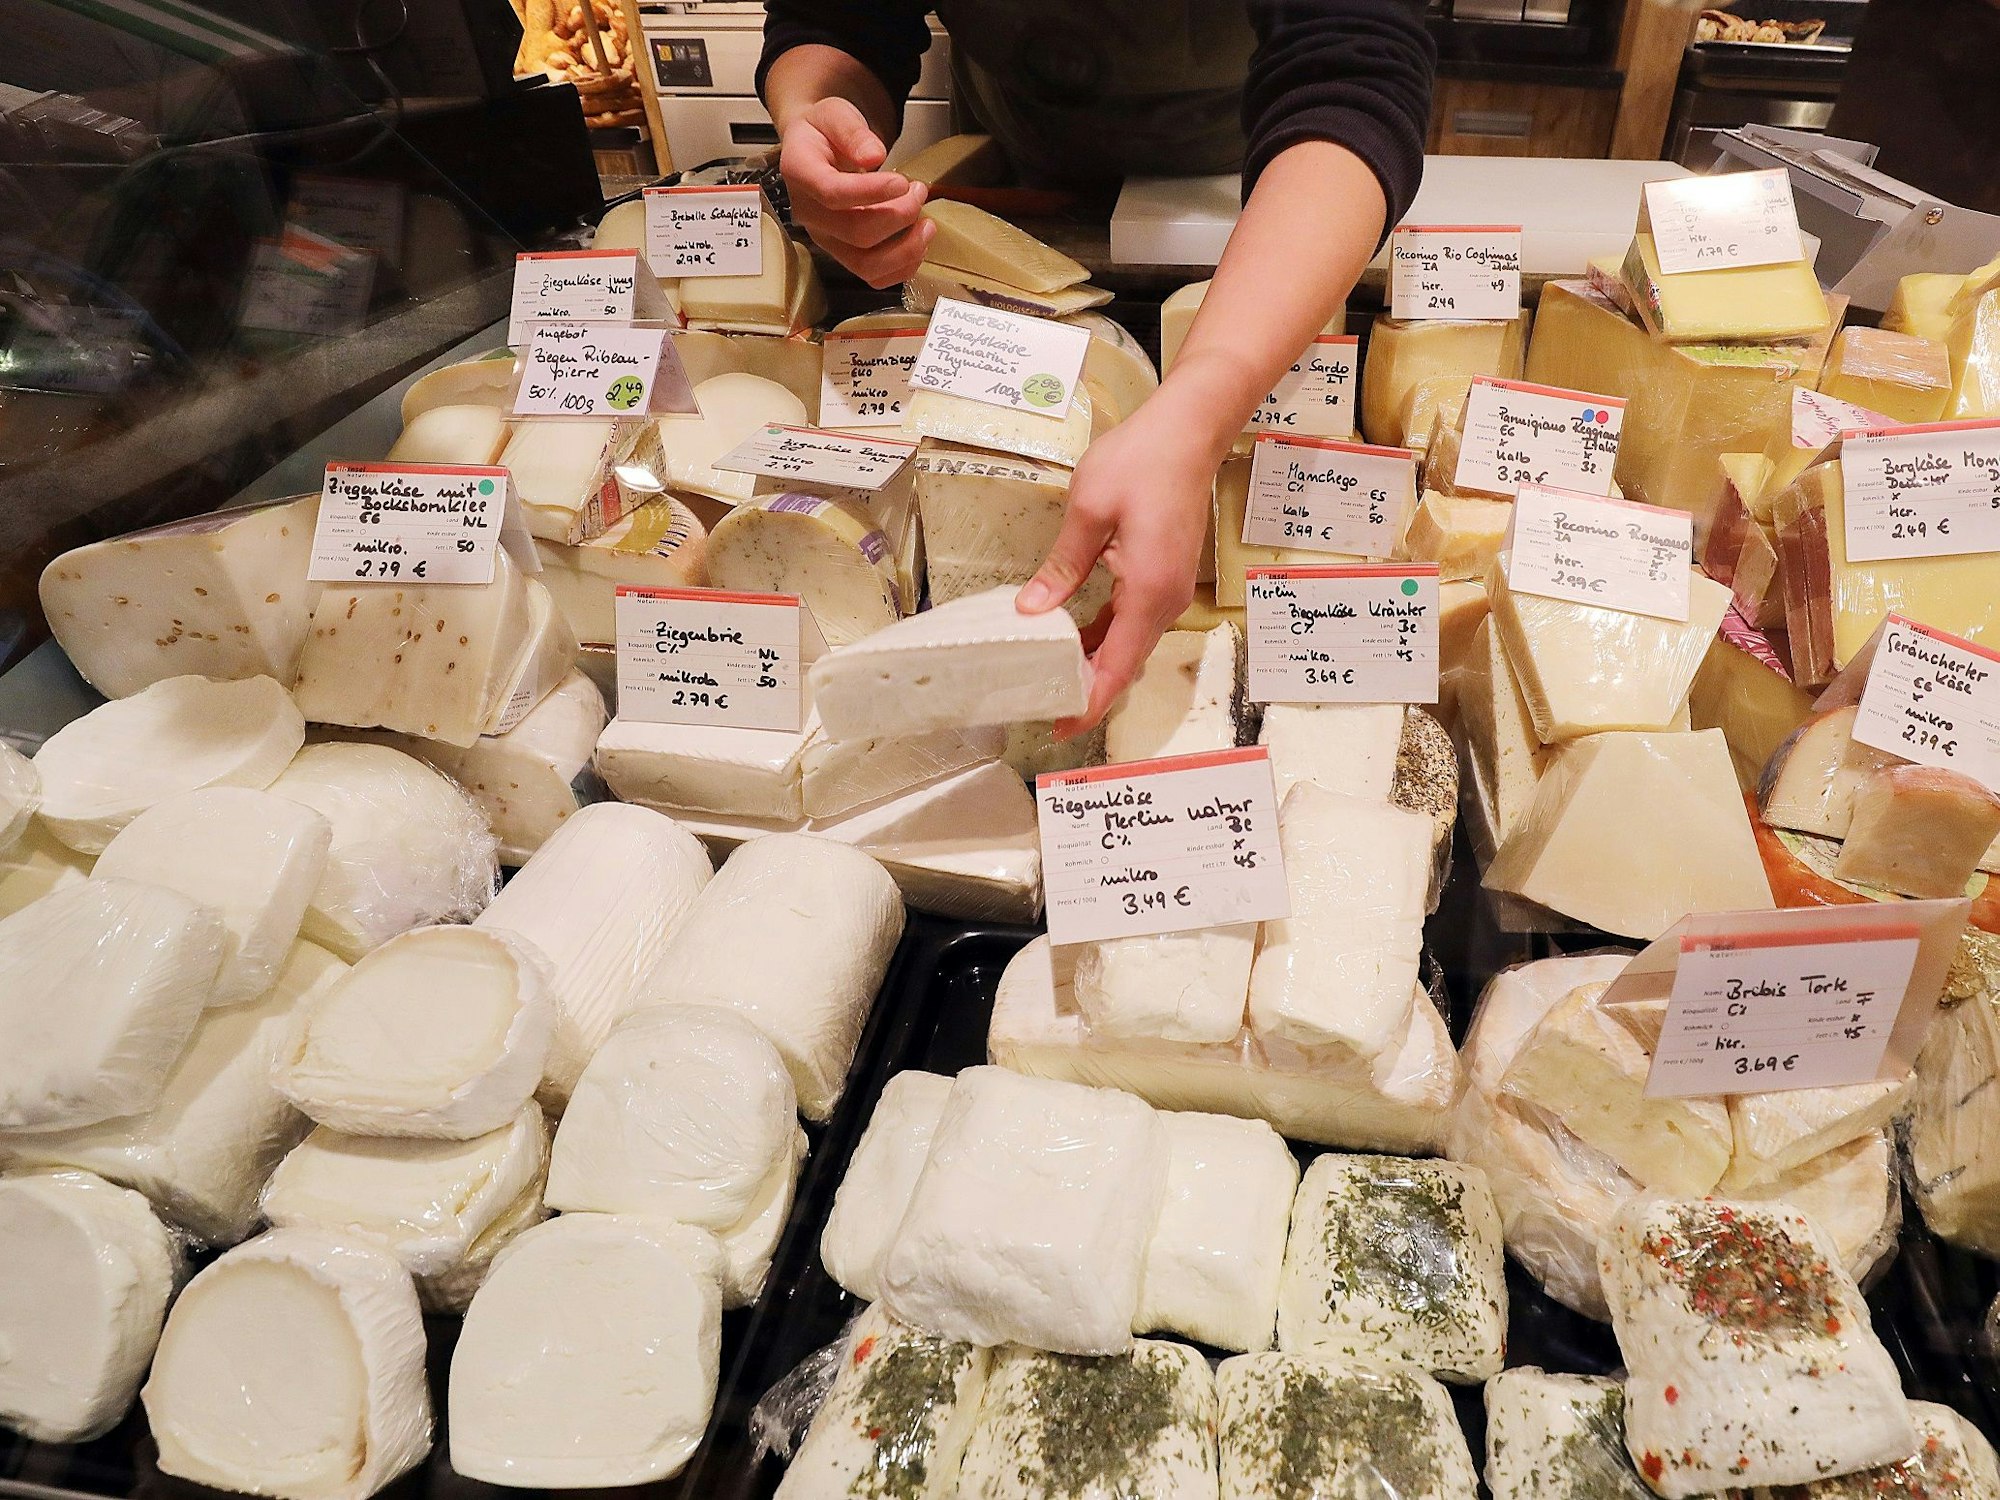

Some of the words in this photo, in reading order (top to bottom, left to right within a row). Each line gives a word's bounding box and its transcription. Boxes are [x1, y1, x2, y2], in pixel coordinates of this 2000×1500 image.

[670, 210, 706, 222] Brebelle
[710, 208, 758, 220] Schafskäse
[1765, 226, 1778, 234] 50
[735, 239, 748, 247] 53
[1395, 247, 1438, 261] Pecorino
[1443, 247, 1461, 260] Rio
[1698, 247, 1723, 258] 1.79
[1728, 244, 1738, 256] €
[676, 254, 701, 265] 2.99
[706, 253, 715, 264] €
[1422, 262, 1438, 271] IA
[543, 274, 601, 291] Ziegenkäse
[606, 275, 633, 289] jung
[1491, 279, 1504, 291] 49
[1428, 297, 1454, 308] 2.49
[604, 306, 616, 315] 50
[536, 328, 588, 339] Angebot
[935, 325, 1031, 357] Schafskäse
[535, 348, 577, 366] Ziegen
[1309, 358, 1349, 373] Sardo
[550, 368, 598, 380] pierre
[985, 382, 1022, 405] 100g
[1045, 391, 1062, 404] €
[560, 392, 594, 414] 100g
[627, 396, 640, 408] €
[858, 403, 885, 415] 2.79
[891, 401, 900, 412] €
[1251, 410, 1280, 424] 2.79
[1283, 413, 1297, 425] €
[1499, 407, 1566, 437] Parmigiano
[765, 462, 801, 472] 2.49
[1581, 461, 1596, 474] 32
[1882, 454, 1952, 477] Bergkäse
[1288, 462, 1358, 491] Manchego
[329, 477, 424, 500] Ziegenkäse
[437, 483, 476, 498] mit
[1370, 490, 1387, 502] ES
[362, 497, 488, 513] Bockshornklee
[1283, 505, 1309, 518] Kalb
[462, 516, 488, 528] NL
[1369, 513, 1383, 524] 50
[1284, 522, 1313, 538] 3.99
[1321, 527, 1334, 539] €
[1554, 512, 1619, 539] Pecorino
[1626, 524, 1690, 551] Romano
[1892, 523, 1927, 538] 2.49
[1937, 518, 1950, 534] €
[353, 540, 407, 555] mikro.
[456, 540, 475, 552] 50
[356, 560, 401, 577] 2.79
[413, 560, 427, 578] €
[1551, 570, 1587, 590] 2.99
[1589, 579, 1607, 593] €
[1251, 585, 1296, 598] Merlin
[1289, 603, 1357, 623] Ziegenkäse
[1369, 599, 1426, 617] Kräuter
[656, 622, 743, 648] Ziegenbrie
[758, 648, 780, 660] NL
[1396, 650, 1413, 661] 45
[756, 676, 777, 688] 50
[1305, 668, 1337, 684] 3.69
[1343, 669, 1354, 684] €
[1936, 671, 1972, 695] Käse
[672, 691, 709, 706] 2.79
[715, 694, 729, 709] €
[1905, 707, 1954, 731] mikro
[1902, 724, 1939, 750] 2.79
[1942, 740, 1958, 756] €
[1045, 784, 1152, 819] Ziegenkäse
[1104, 811, 1174, 831] Merlin
[1187, 797, 1253, 821] natur
[1207, 823, 1223, 831] Land
[1057, 840, 1092, 849] Bioqualität
[1064, 858, 1093, 867] Rohmilch
[1233, 851, 1257, 868] 45
[1101, 868, 1158, 886] mikro
[1122, 891, 1166, 915] 3.49
[1174, 886, 1191, 906] €
[1800, 975, 1848, 994] Torte
[1844, 1025, 1865, 1039] 45
[1735, 1057, 1776, 1075] 3.69
[1783, 1055, 1800, 1071] €
